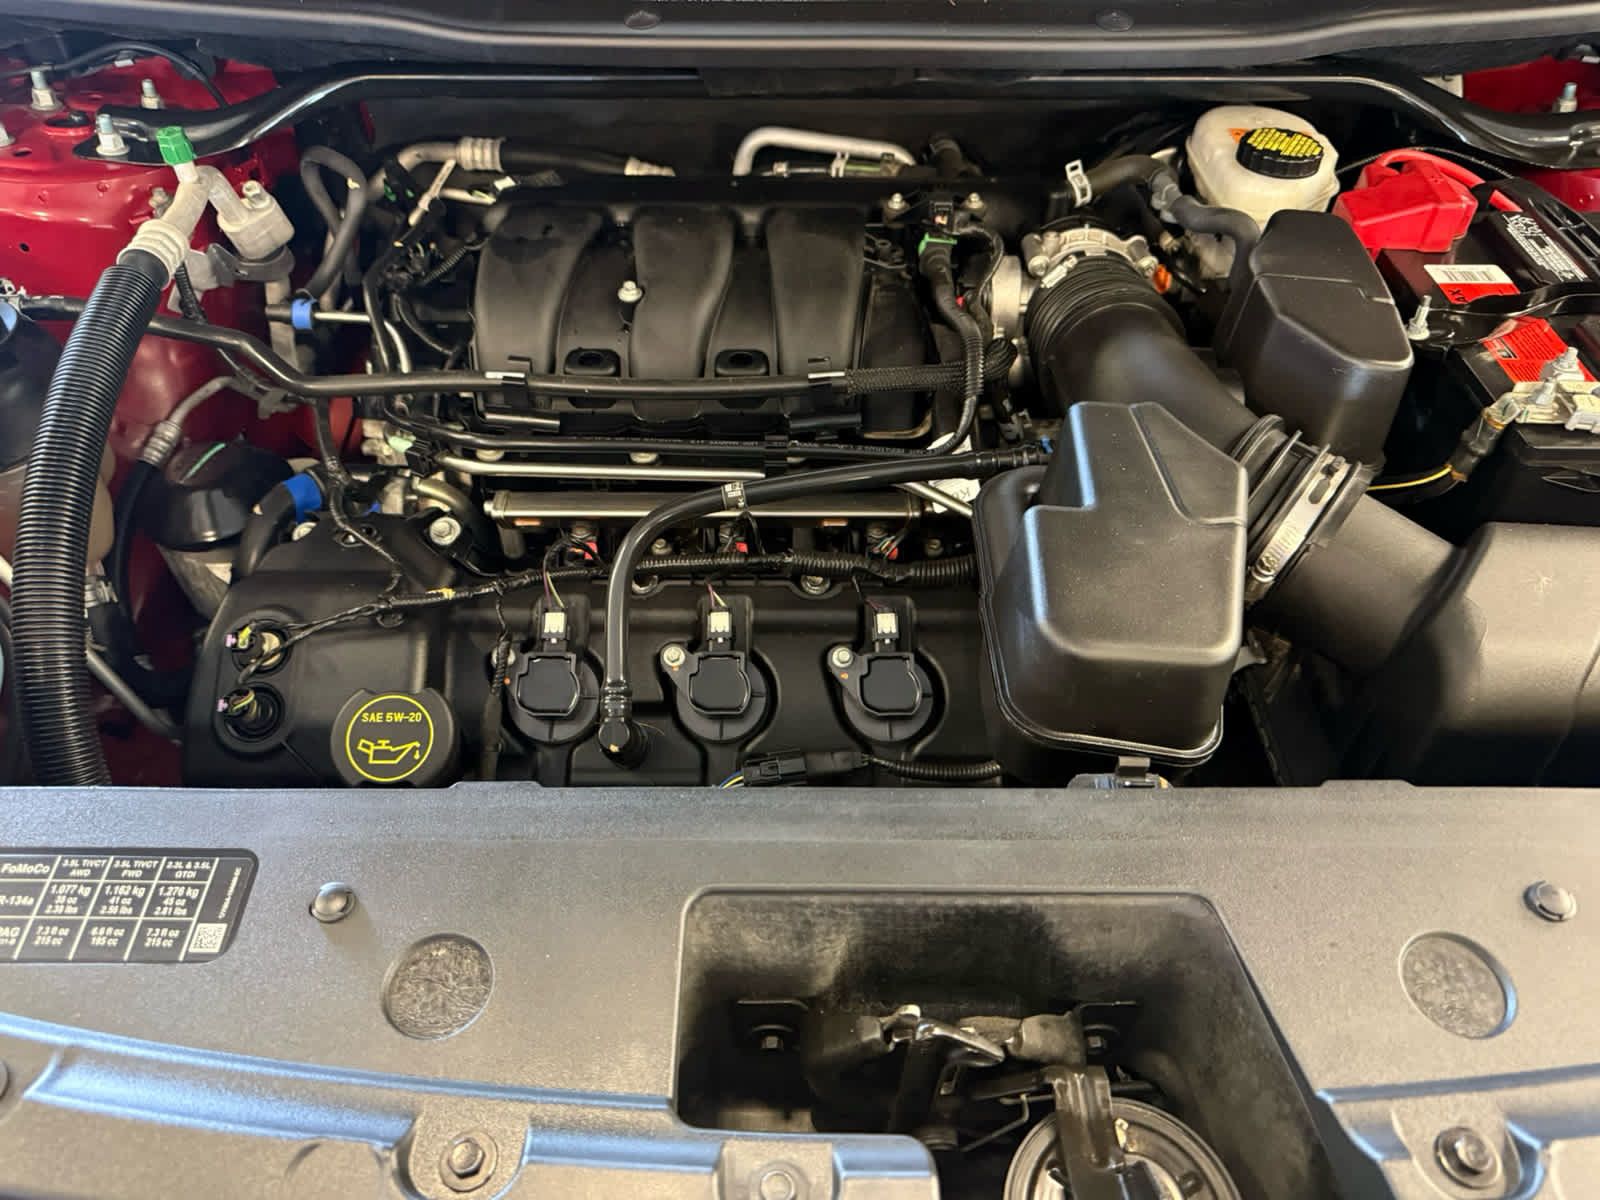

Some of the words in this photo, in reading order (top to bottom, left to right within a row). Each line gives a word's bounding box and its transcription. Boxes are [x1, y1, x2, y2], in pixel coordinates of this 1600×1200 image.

[361, 712, 384, 723] SAE
[385, 712, 422, 723] 5W-20
[1, 863, 50, 874] FoMoCo
[121, 869, 143, 878] FWD
[77, 884, 92, 897] kg
[132, 885, 146, 898] kg
[185, 887, 200, 900] kg
